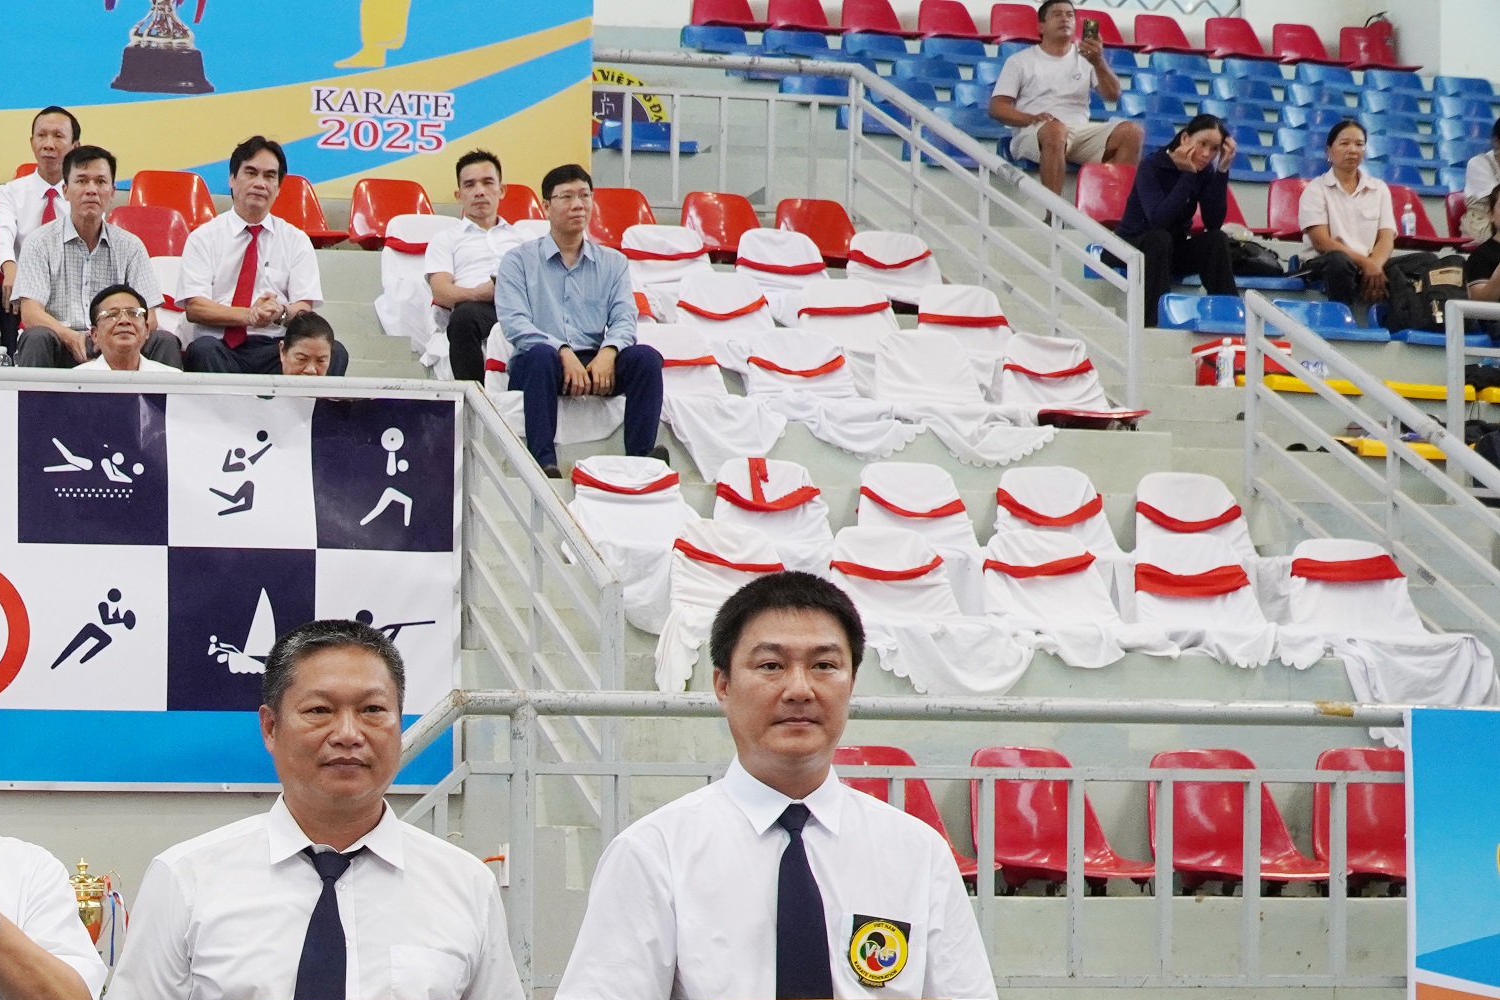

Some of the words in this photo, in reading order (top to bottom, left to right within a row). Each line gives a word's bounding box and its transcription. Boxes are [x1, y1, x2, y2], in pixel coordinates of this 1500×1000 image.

[314, 89, 451, 118] KARATE
[321, 118, 443, 151] 2025
[865, 942, 896, 961] VKF
[854, 960, 868, 977] KARATE
[869, 970, 898, 979] FEDERATION
